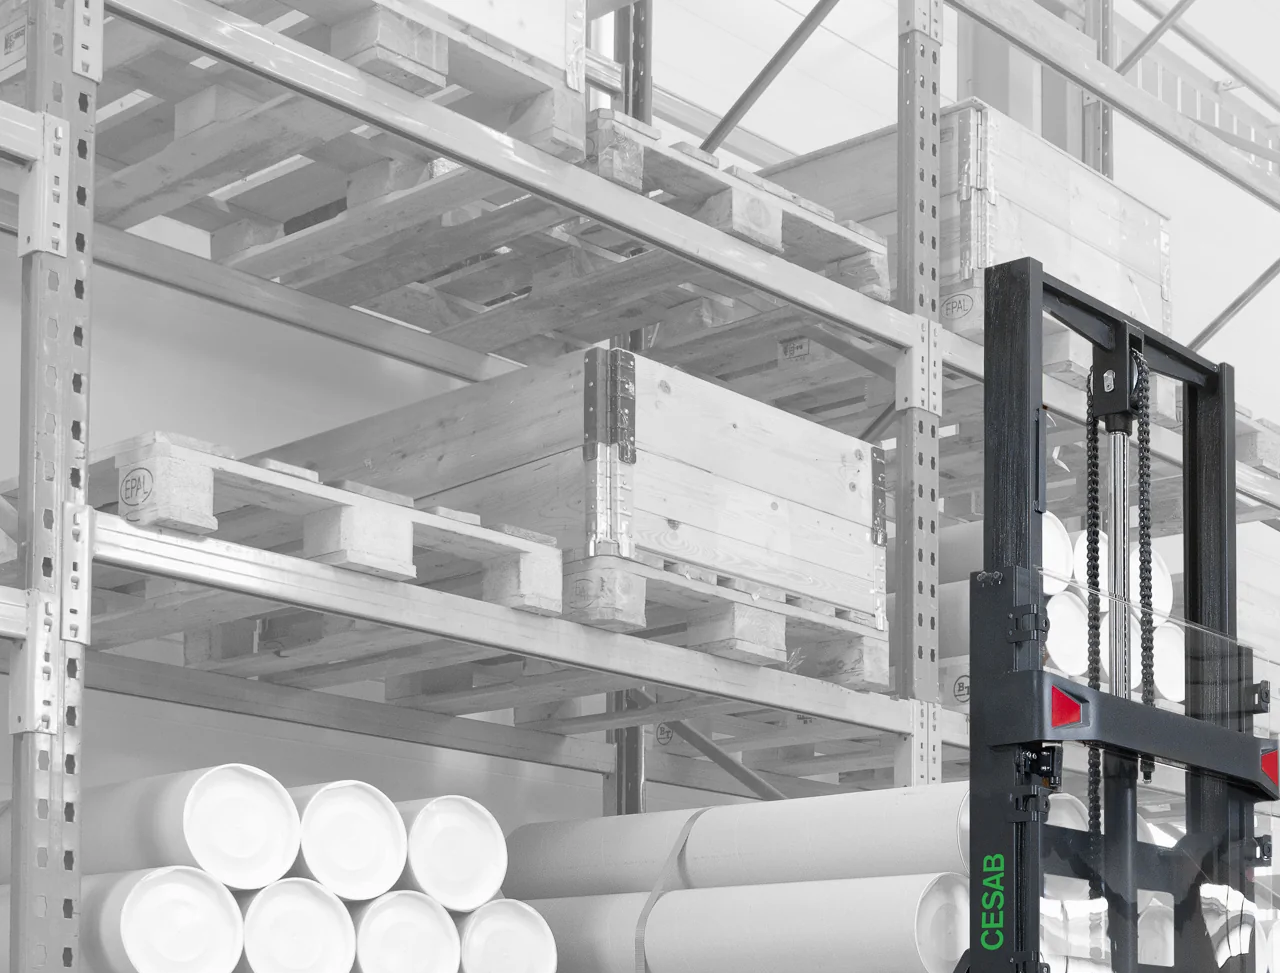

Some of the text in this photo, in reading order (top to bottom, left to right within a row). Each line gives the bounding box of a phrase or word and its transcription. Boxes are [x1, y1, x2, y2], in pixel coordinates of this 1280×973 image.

[125, 475, 148, 499] EPAL
[660, 726, 671, 739] BT
[980, 853, 1005, 951] CESAB
